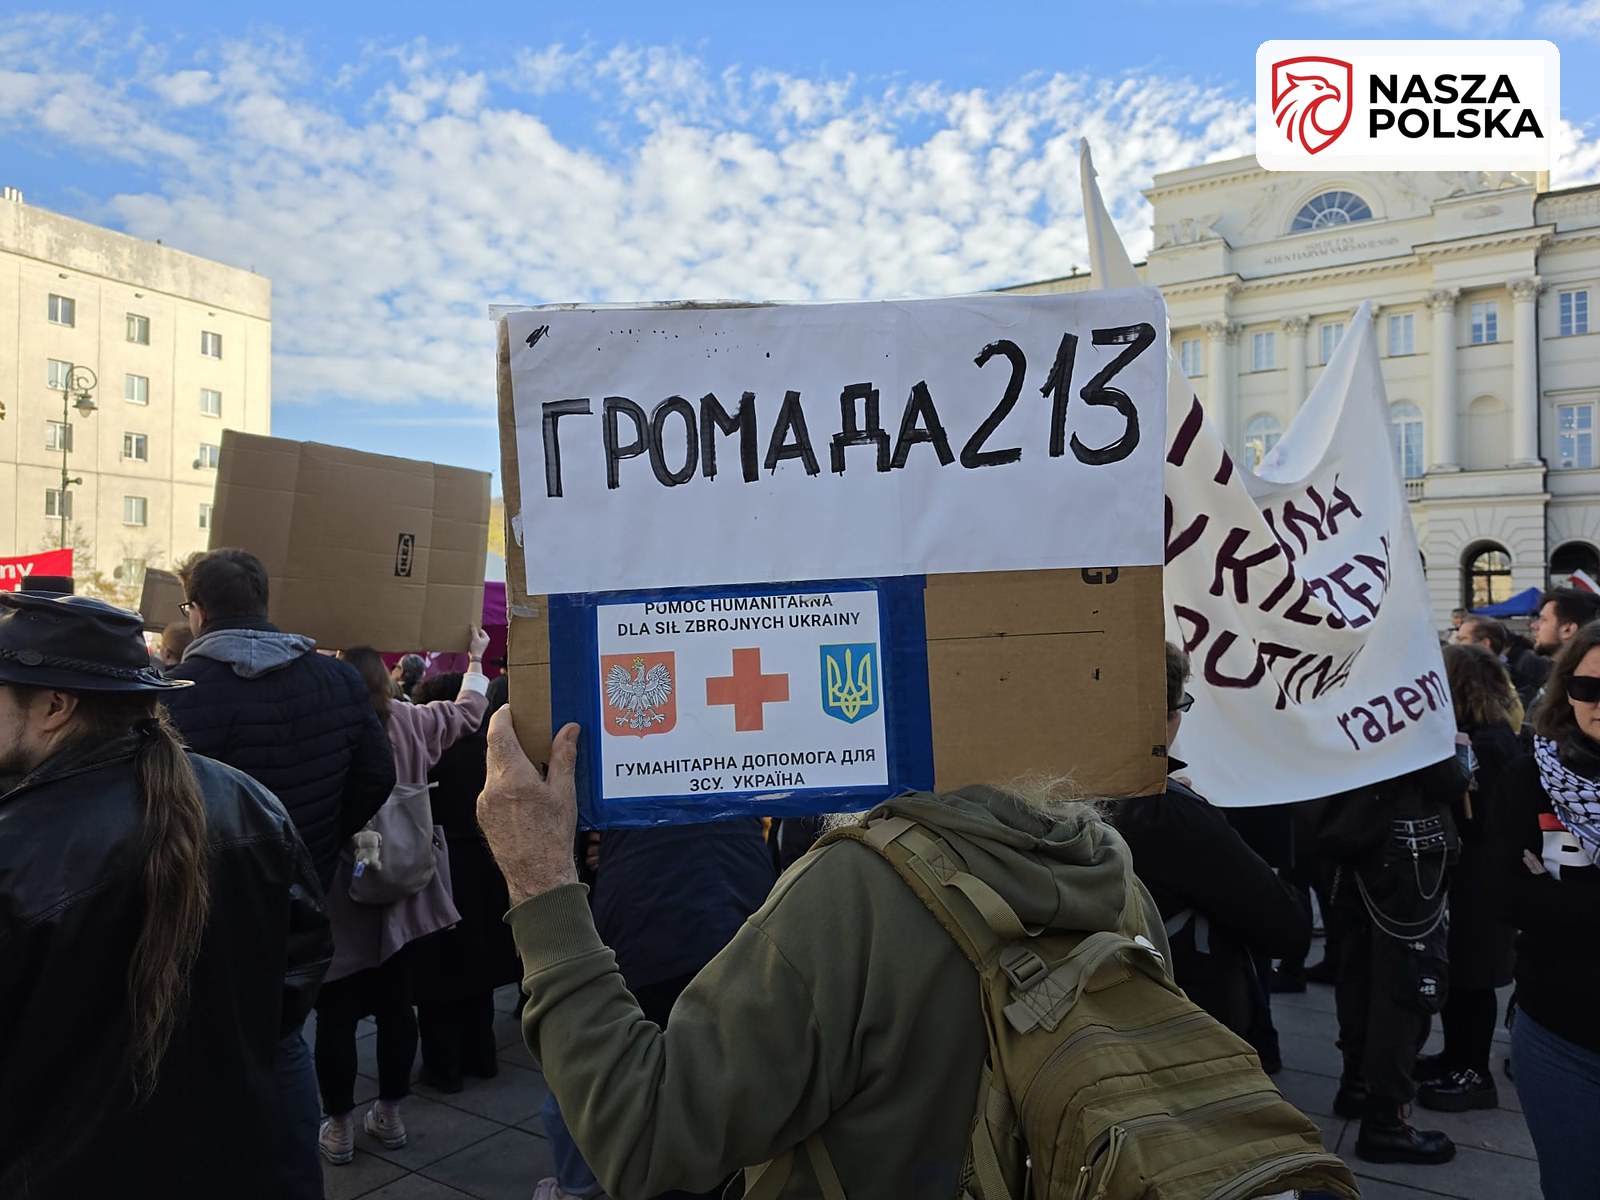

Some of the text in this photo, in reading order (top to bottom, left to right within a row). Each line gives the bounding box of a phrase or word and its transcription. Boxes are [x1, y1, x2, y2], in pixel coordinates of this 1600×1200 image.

[398, 535, 412, 575] IKEA
[644, 594, 833, 615] POMOC HUMANITARNA
[617, 611, 860, 637] DLA SIŁ ZBROJNYCH UKRAINY
[1336, 670, 1449, 751] razem
[615, 748, 876, 777] ГУМАНІТАРНА ДОПОМОГА ДЛЯ
[689, 771, 805, 791] ЗСУ. УКРАЇНА
